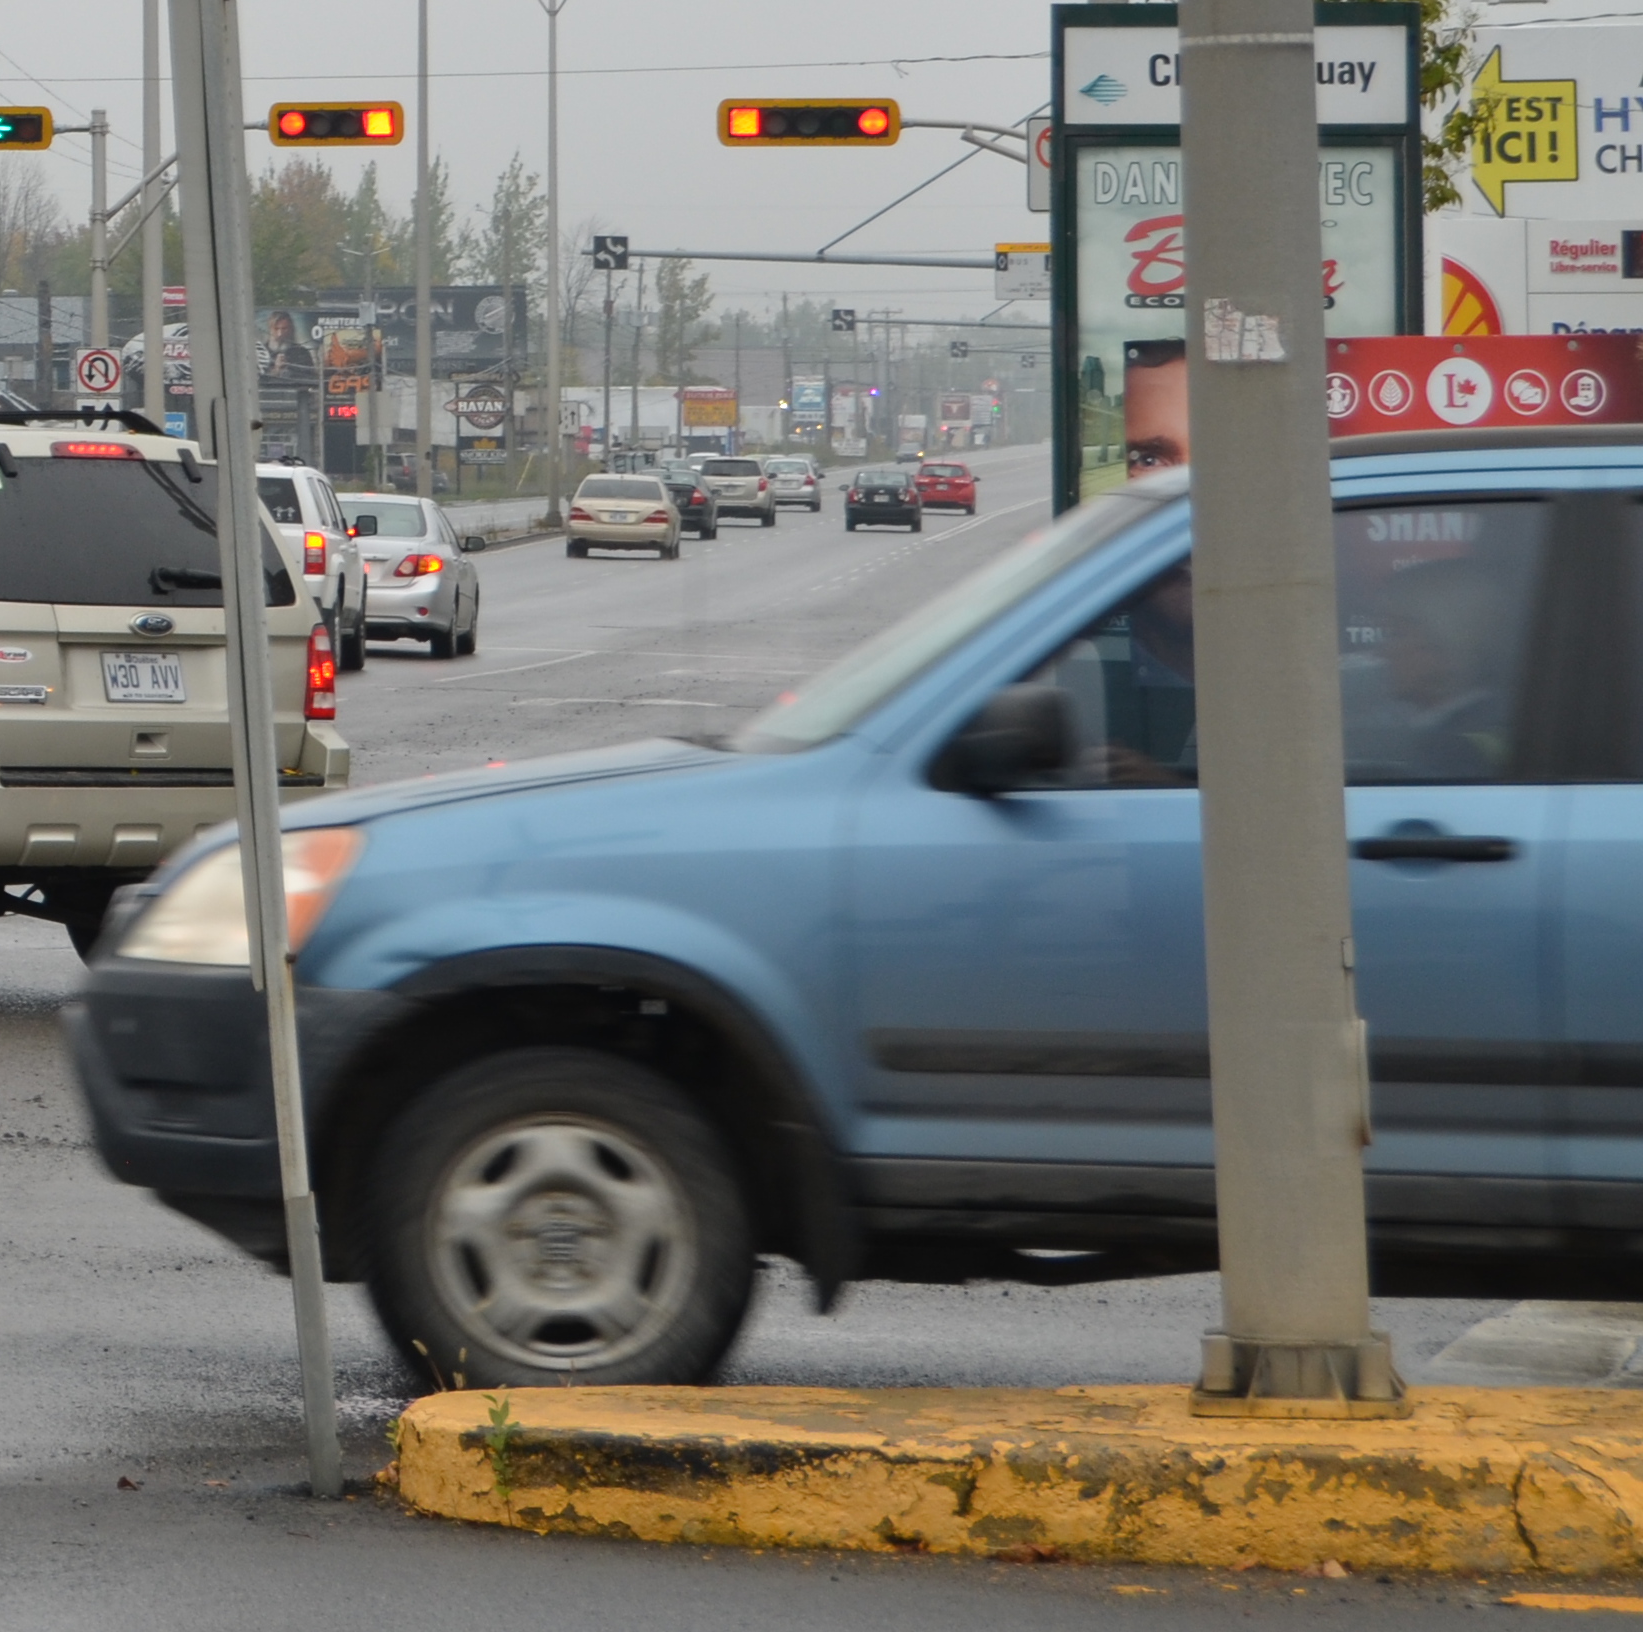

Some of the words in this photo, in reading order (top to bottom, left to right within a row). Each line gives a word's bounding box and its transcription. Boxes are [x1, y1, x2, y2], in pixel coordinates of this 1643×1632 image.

[1550, 240, 1618, 259] Régulier
[1550, 262, 1619, 273] Libre-service
[458, 400, 504, 412] HAVAN
[107, 664, 140, 689] W30
[151, 664, 180, 690] AVV
